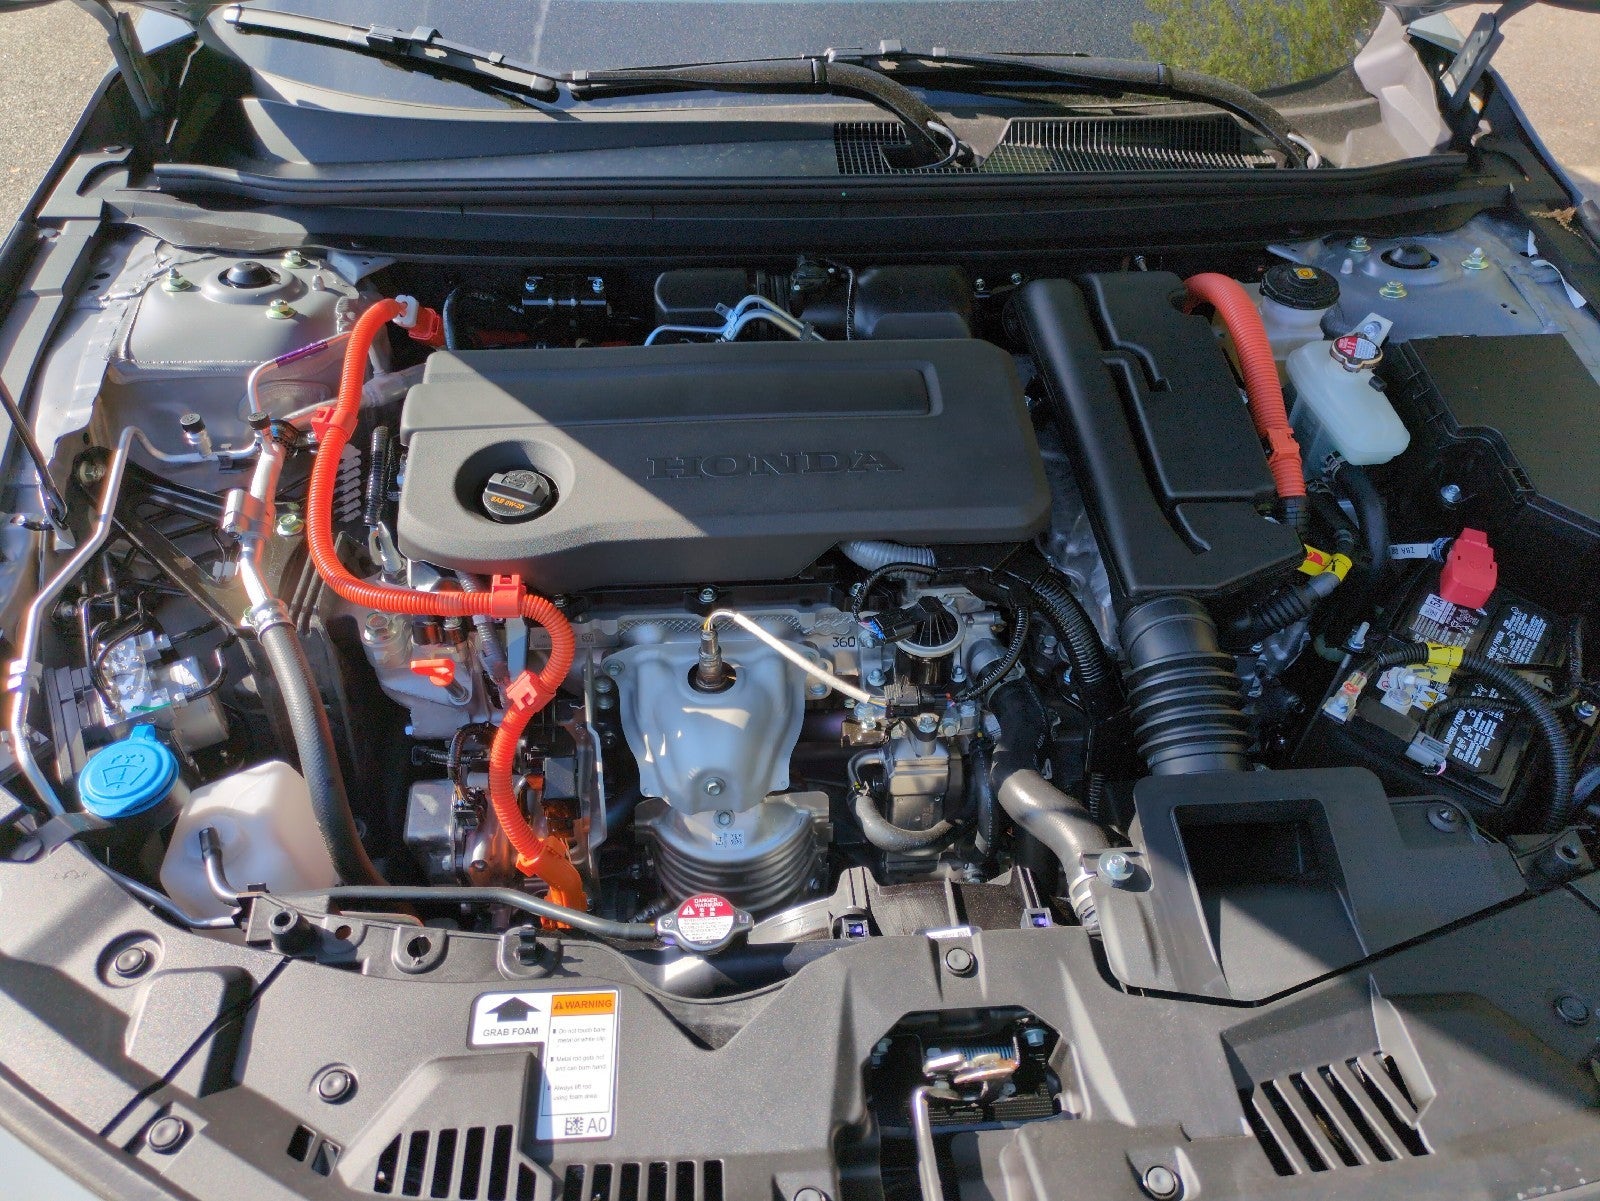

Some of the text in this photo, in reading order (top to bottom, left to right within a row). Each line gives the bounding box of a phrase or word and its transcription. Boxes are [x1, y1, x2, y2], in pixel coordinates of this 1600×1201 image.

[646, 450, 904, 479] HONDA
[832, 636, 856, 648] 360
[565, 1000, 612, 1010] WARNING
[483, 1027, 539, 1037] GRAB FOAM
[587, 1116, 607, 1133] A0
